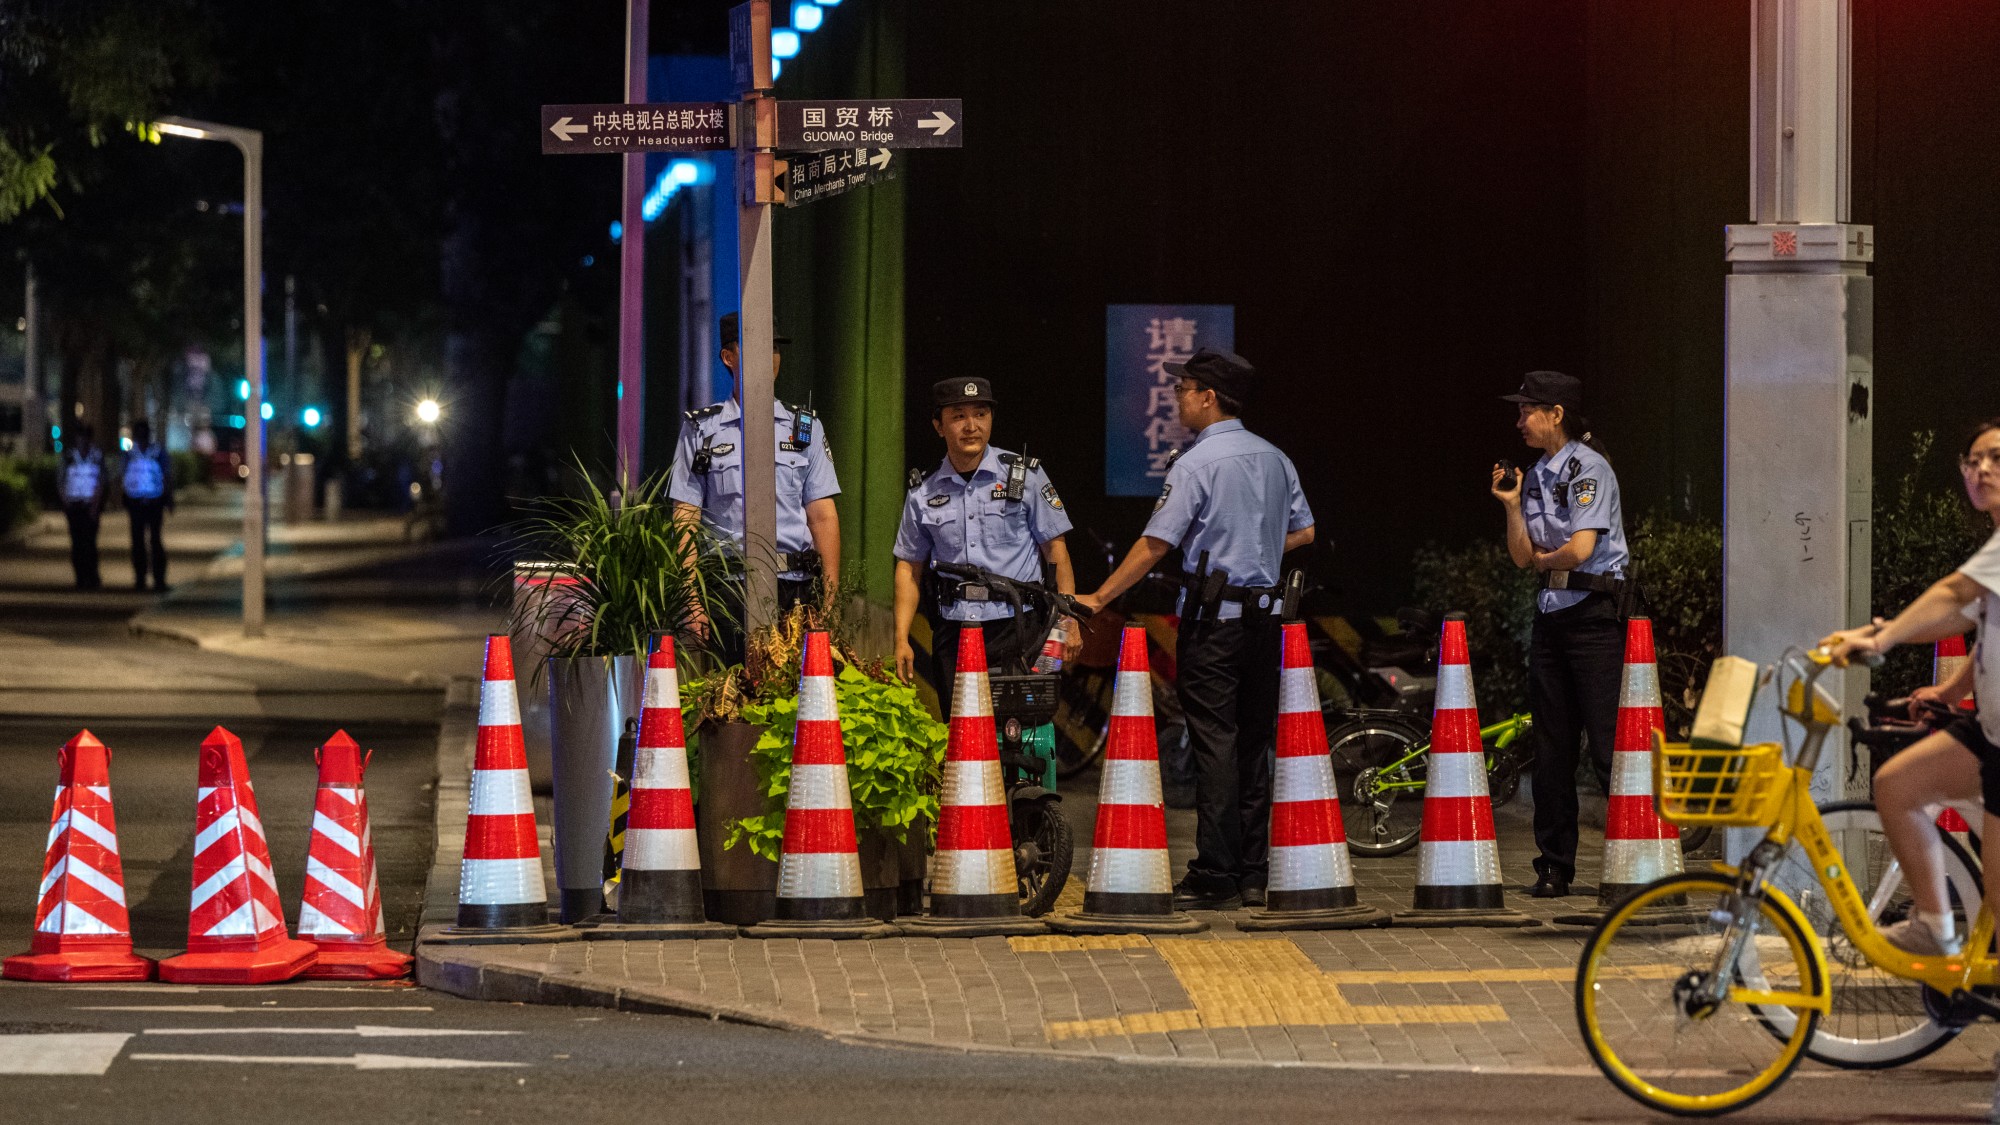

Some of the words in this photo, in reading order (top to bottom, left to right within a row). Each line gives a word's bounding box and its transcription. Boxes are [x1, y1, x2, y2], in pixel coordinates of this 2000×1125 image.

[593, 109, 724, 131] 中央电视台总部大楼
[803, 107, 893, 128] 国贸桥
[593, 137, 630, 146] CCTV
[638, 136, 725, 146] Headquarters
[803, 131, 855, 142] GUOMAO
[860, 131, 893, 143] Bridge
[793, 148, 868, 184] 招商局大厦
[794, 188, 811, 200] China
[814, 178, 845, 195] Merchants
[847, 172, 866, 184] Tower
